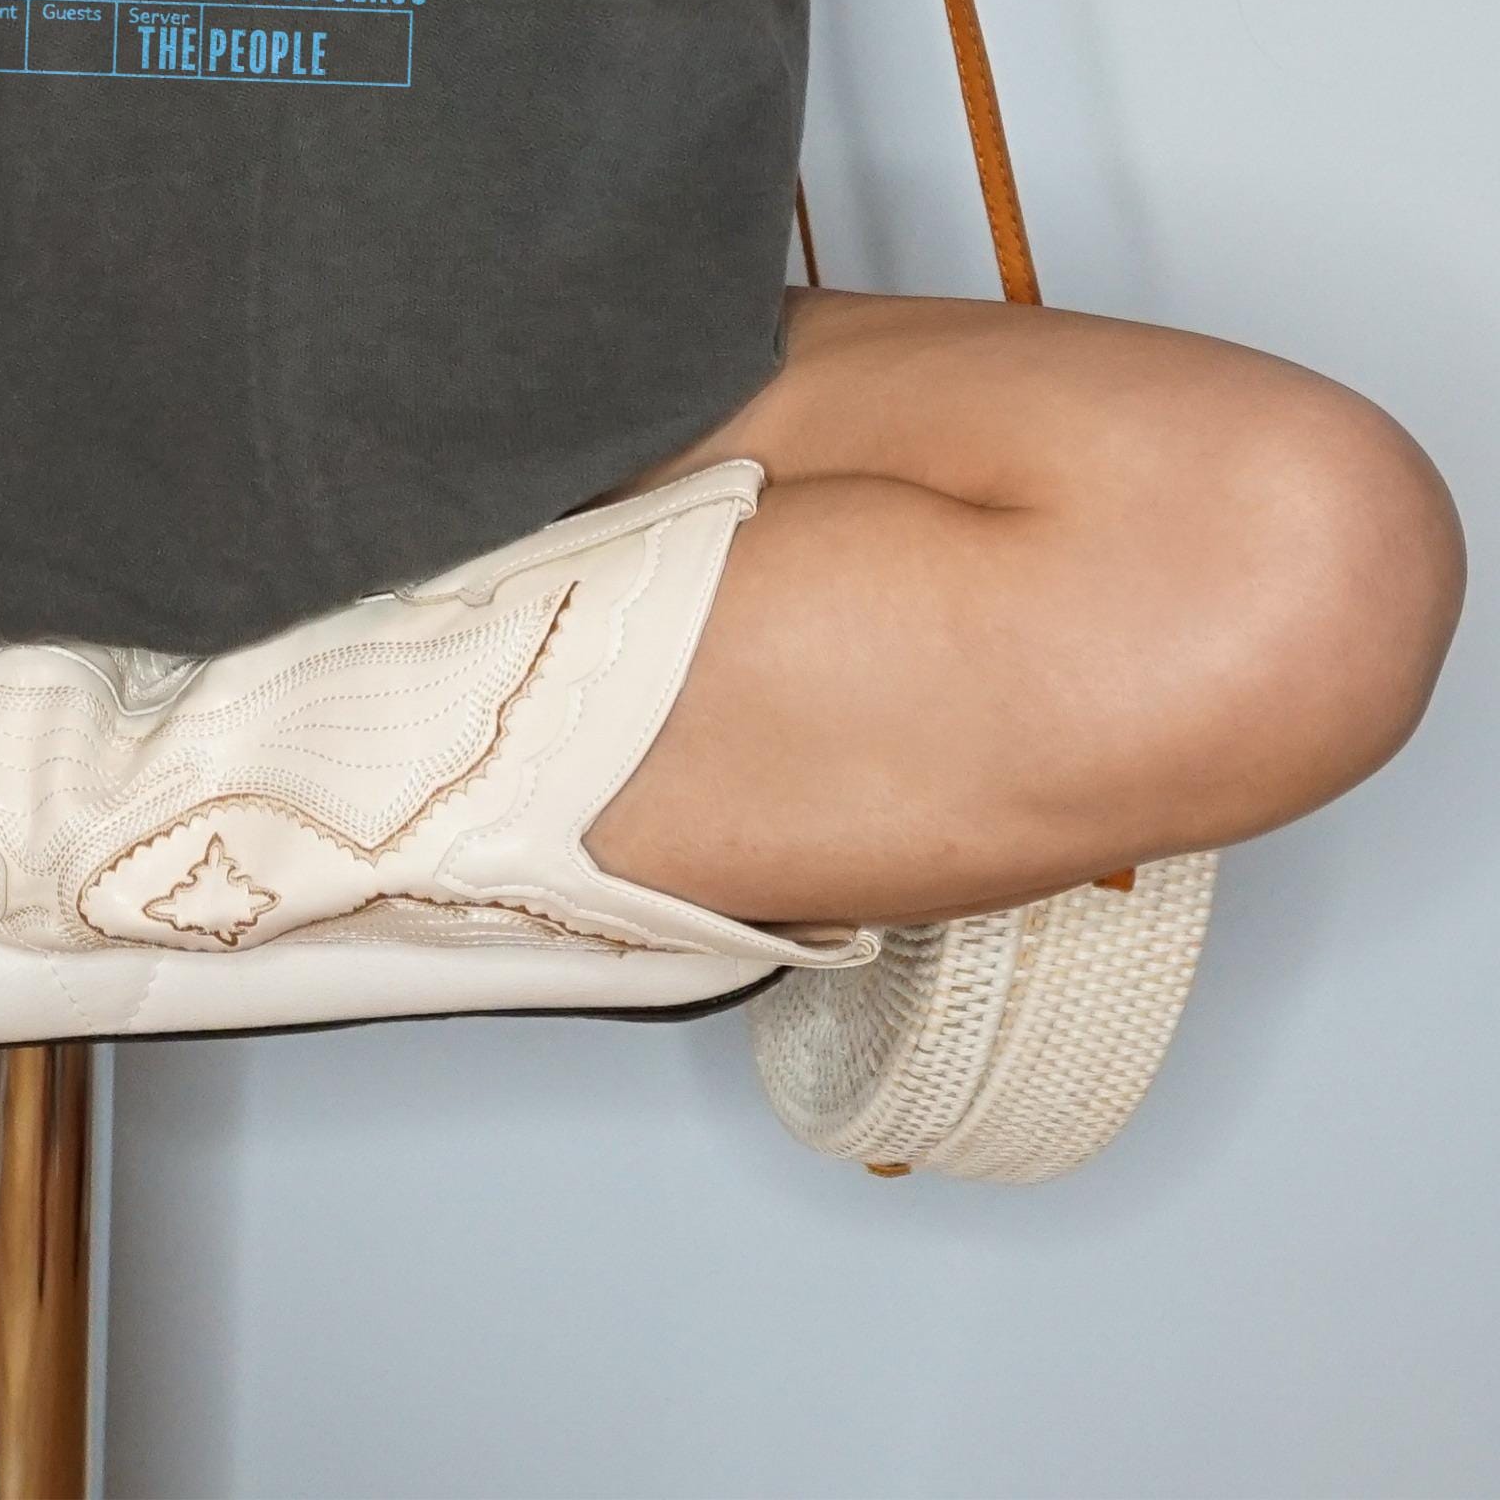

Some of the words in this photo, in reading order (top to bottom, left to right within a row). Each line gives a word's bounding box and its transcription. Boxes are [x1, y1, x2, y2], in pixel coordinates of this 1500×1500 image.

[41, 4, 103, 23] Guests
[128, 7, 191, 26] Server
[137, 25, 197, 71] THE
[209, 28, 328, 76] PEOPLE
